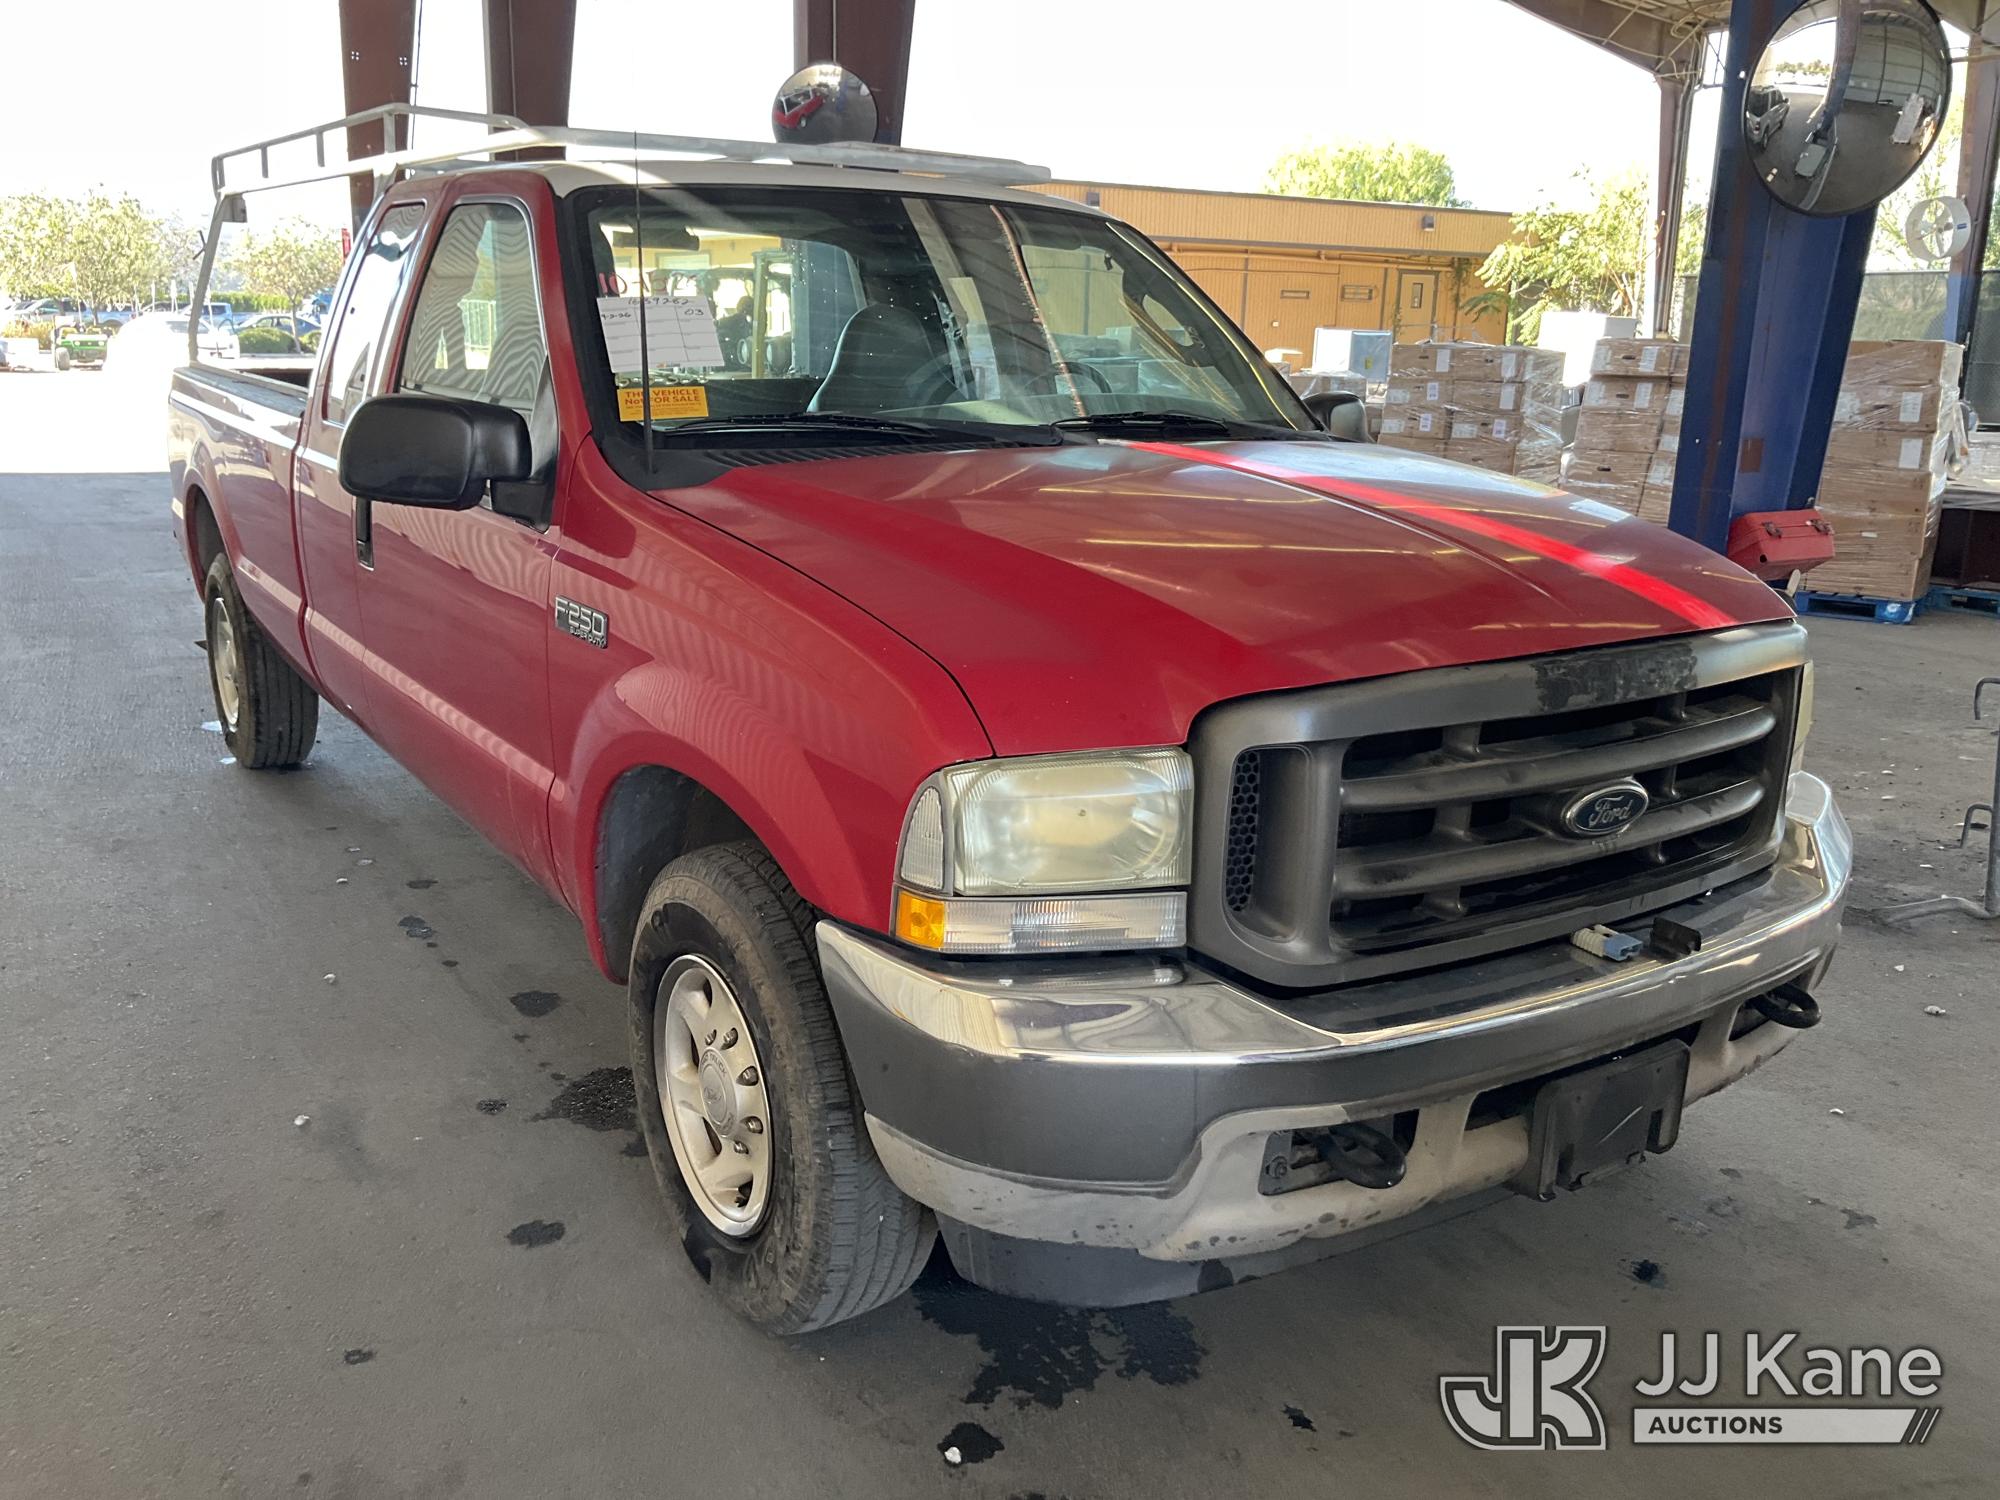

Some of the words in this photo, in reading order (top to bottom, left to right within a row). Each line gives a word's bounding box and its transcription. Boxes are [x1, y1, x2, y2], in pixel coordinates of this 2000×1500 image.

[652, 388, 700, 397] VEHICLE
[673, 395, 700, 403] SALE
[1588, 795, 1634, 828] Ford
